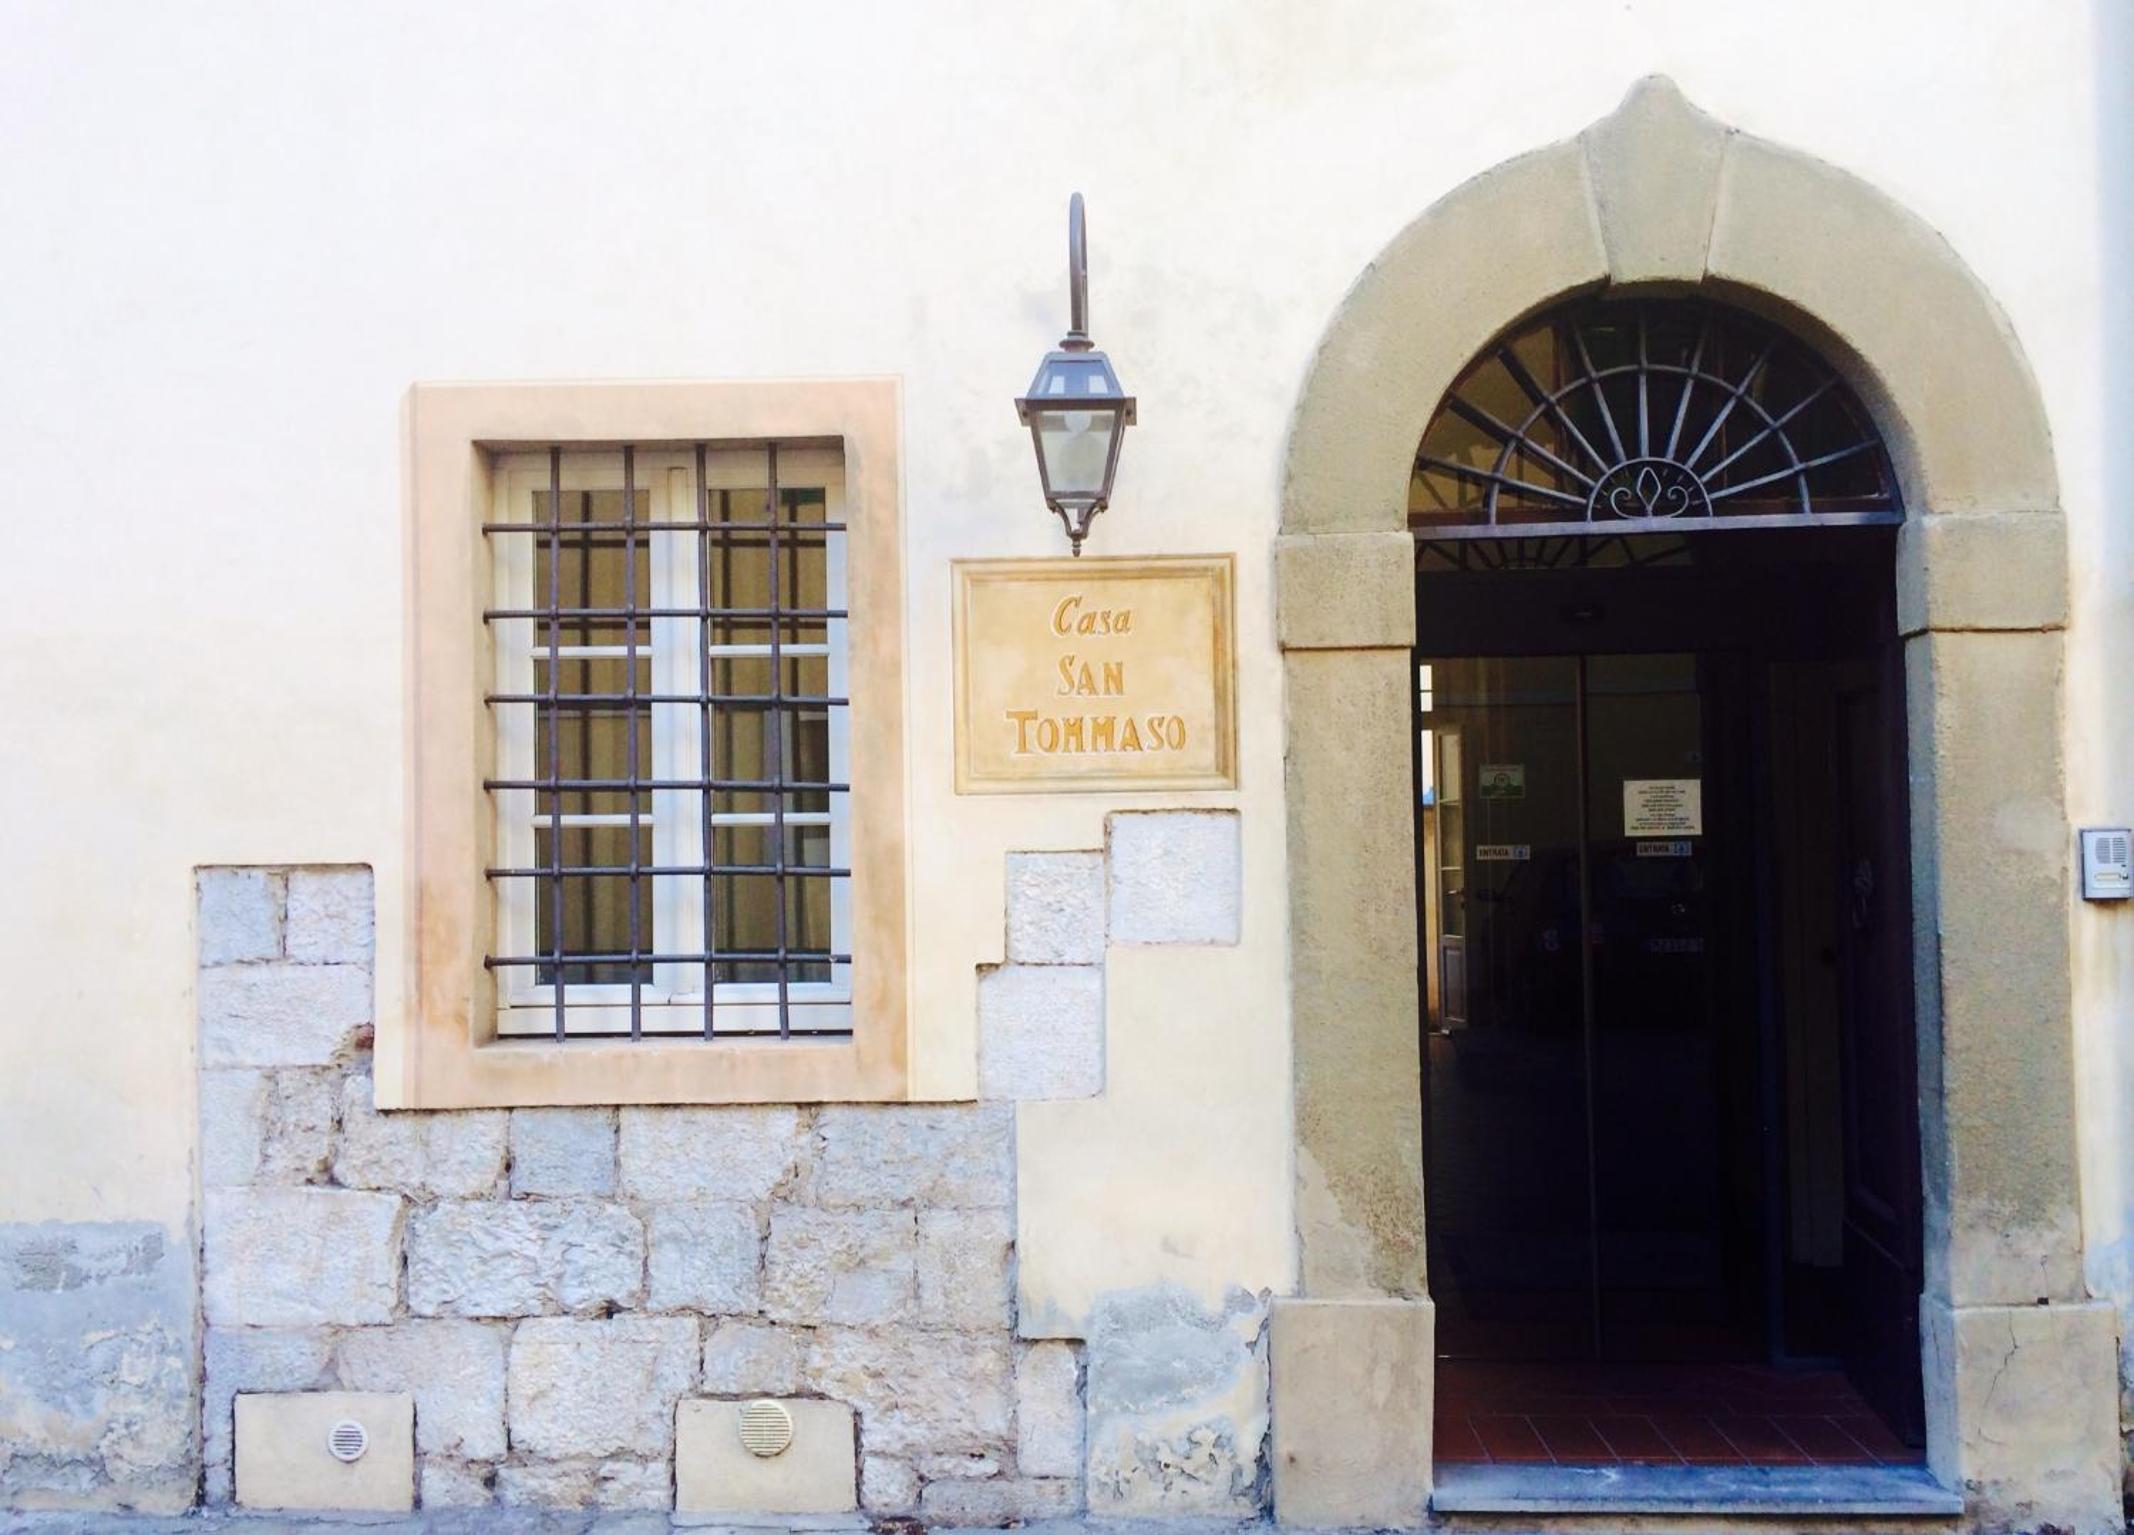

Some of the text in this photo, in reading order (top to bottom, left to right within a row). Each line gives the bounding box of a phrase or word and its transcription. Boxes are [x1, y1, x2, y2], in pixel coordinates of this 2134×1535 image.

[1053, 595, 1132, 636] Casa
[1057, 655, 1125, 696] SAN
[1006, 709, 1187, 754] TOMMASO
